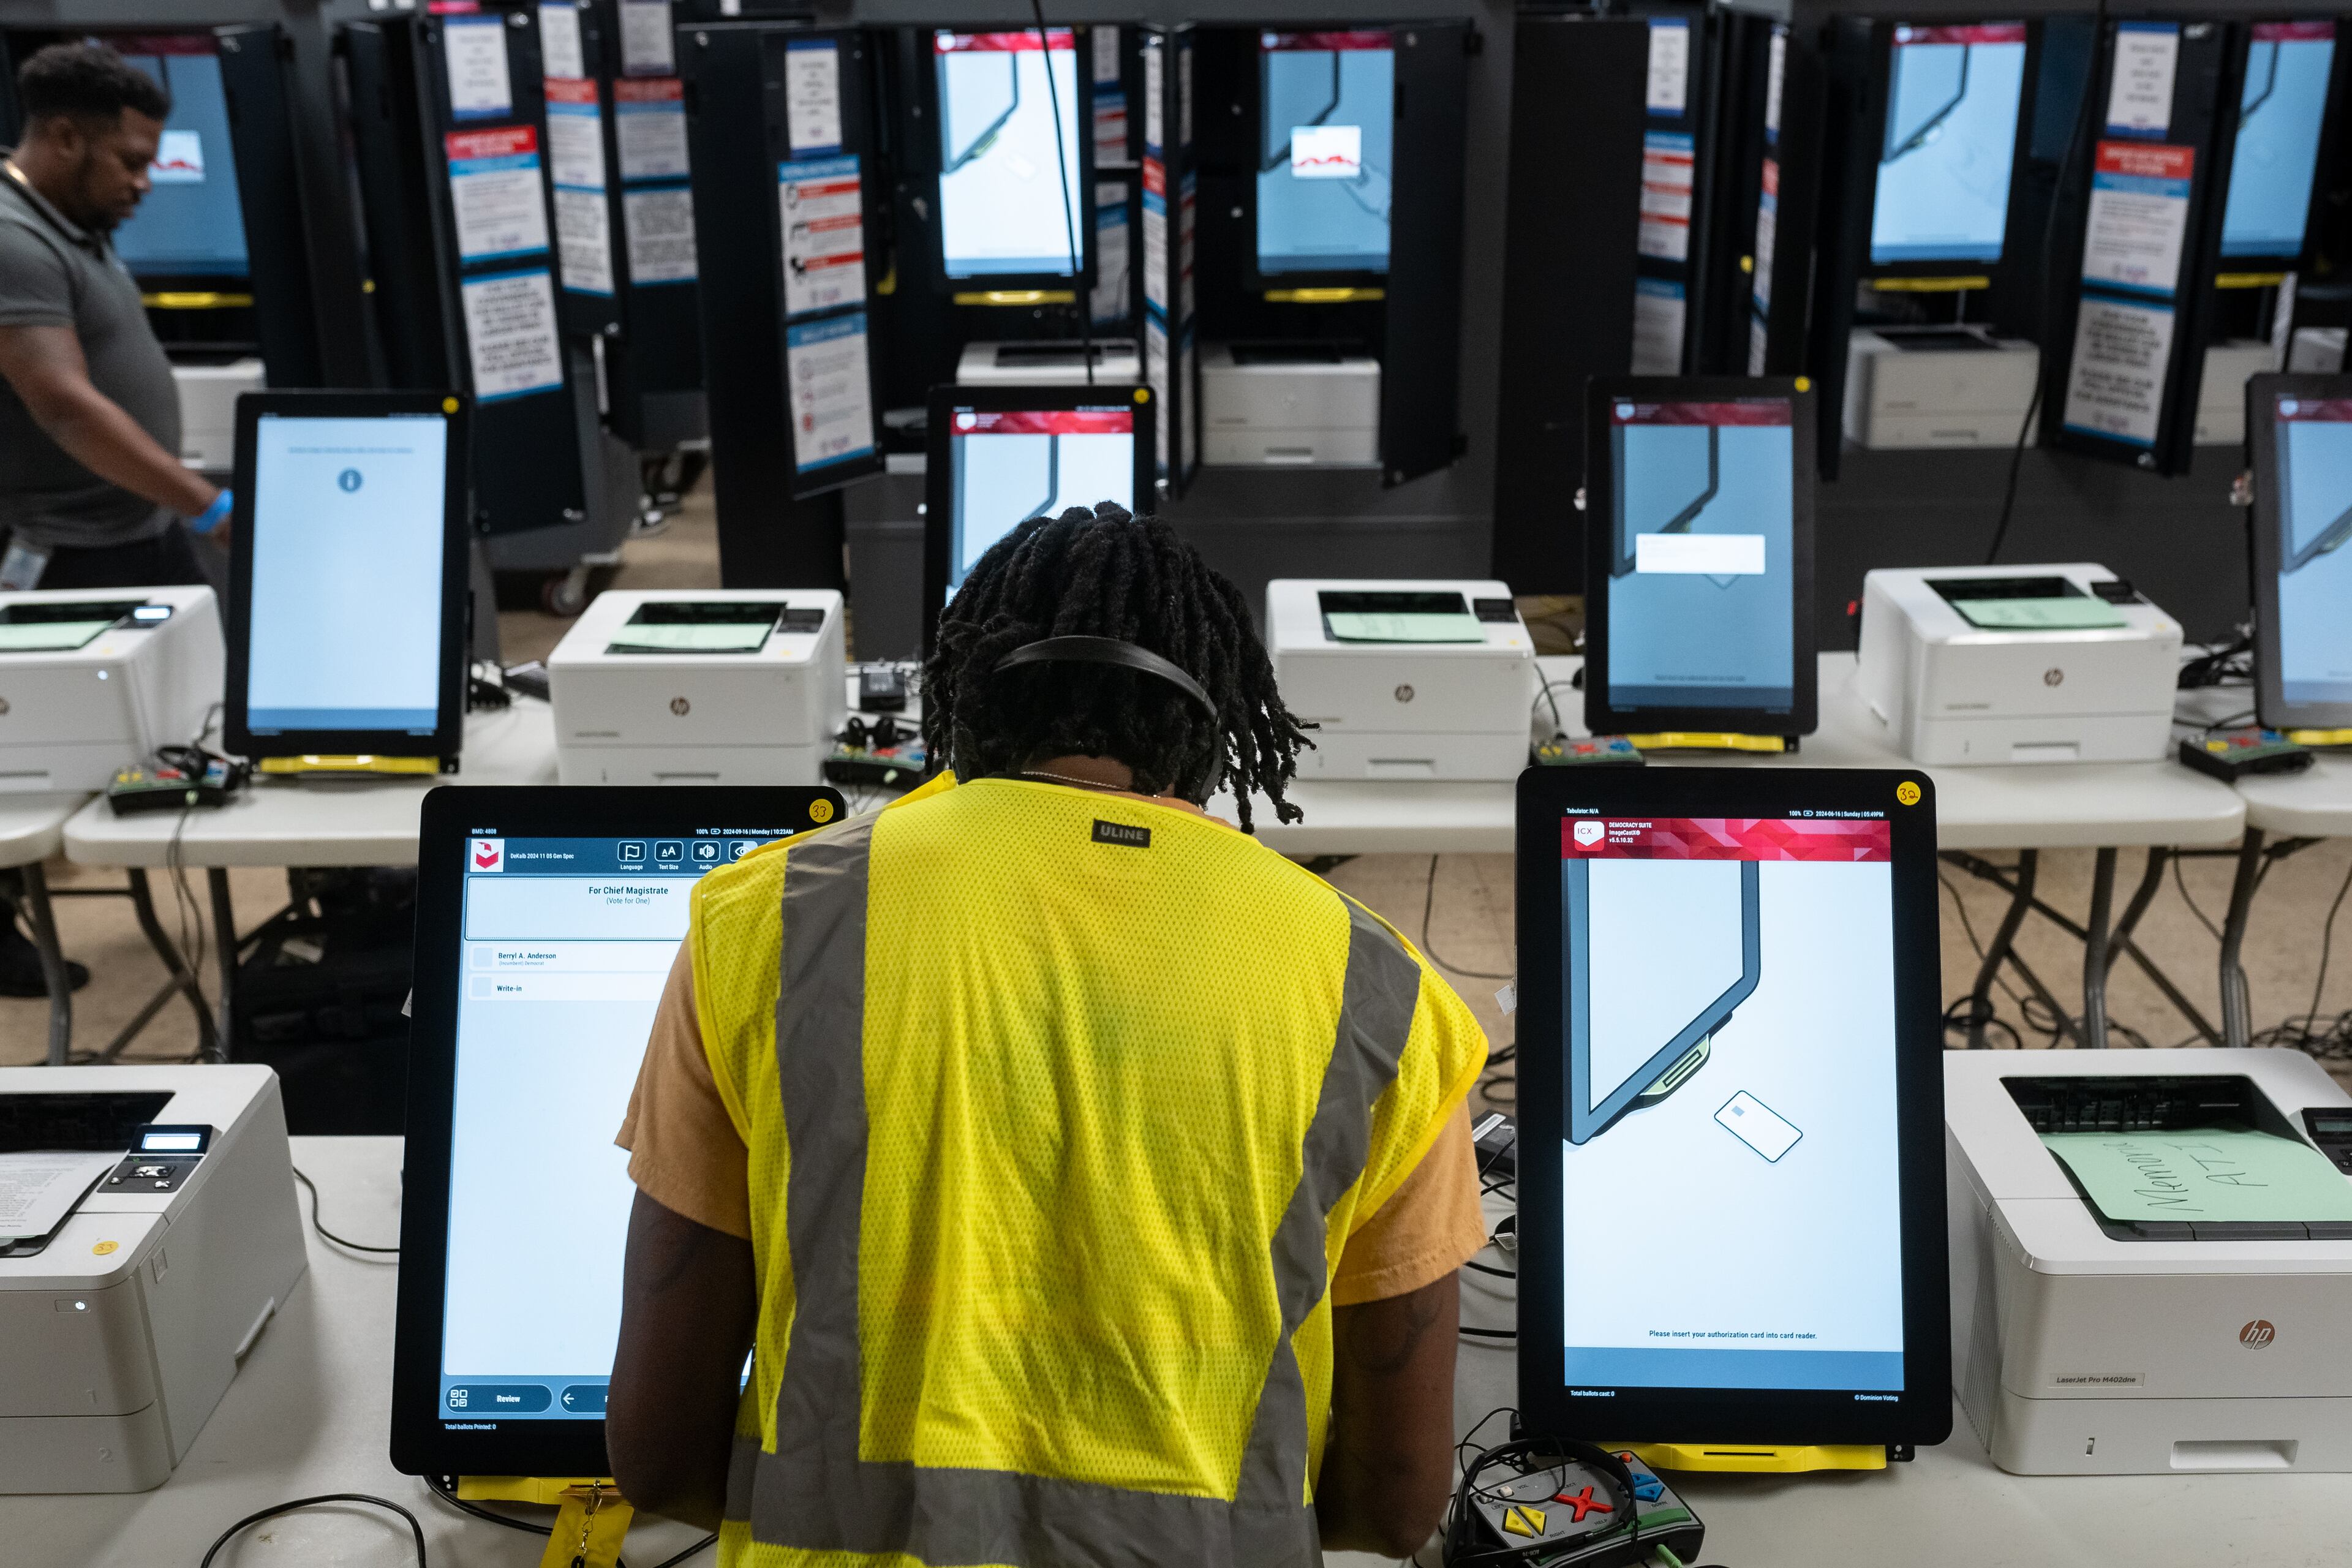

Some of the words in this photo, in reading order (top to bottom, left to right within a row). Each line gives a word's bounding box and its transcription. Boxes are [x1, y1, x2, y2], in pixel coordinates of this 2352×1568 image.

[1899, 788, 1918, 801] 32
[813, 805, 827, 818] 33
[1100, 825, 1144, 840] ULINE
[626, 887, 668, 896] Magistrate
[2242, 1319, 2273, 1350] hp
